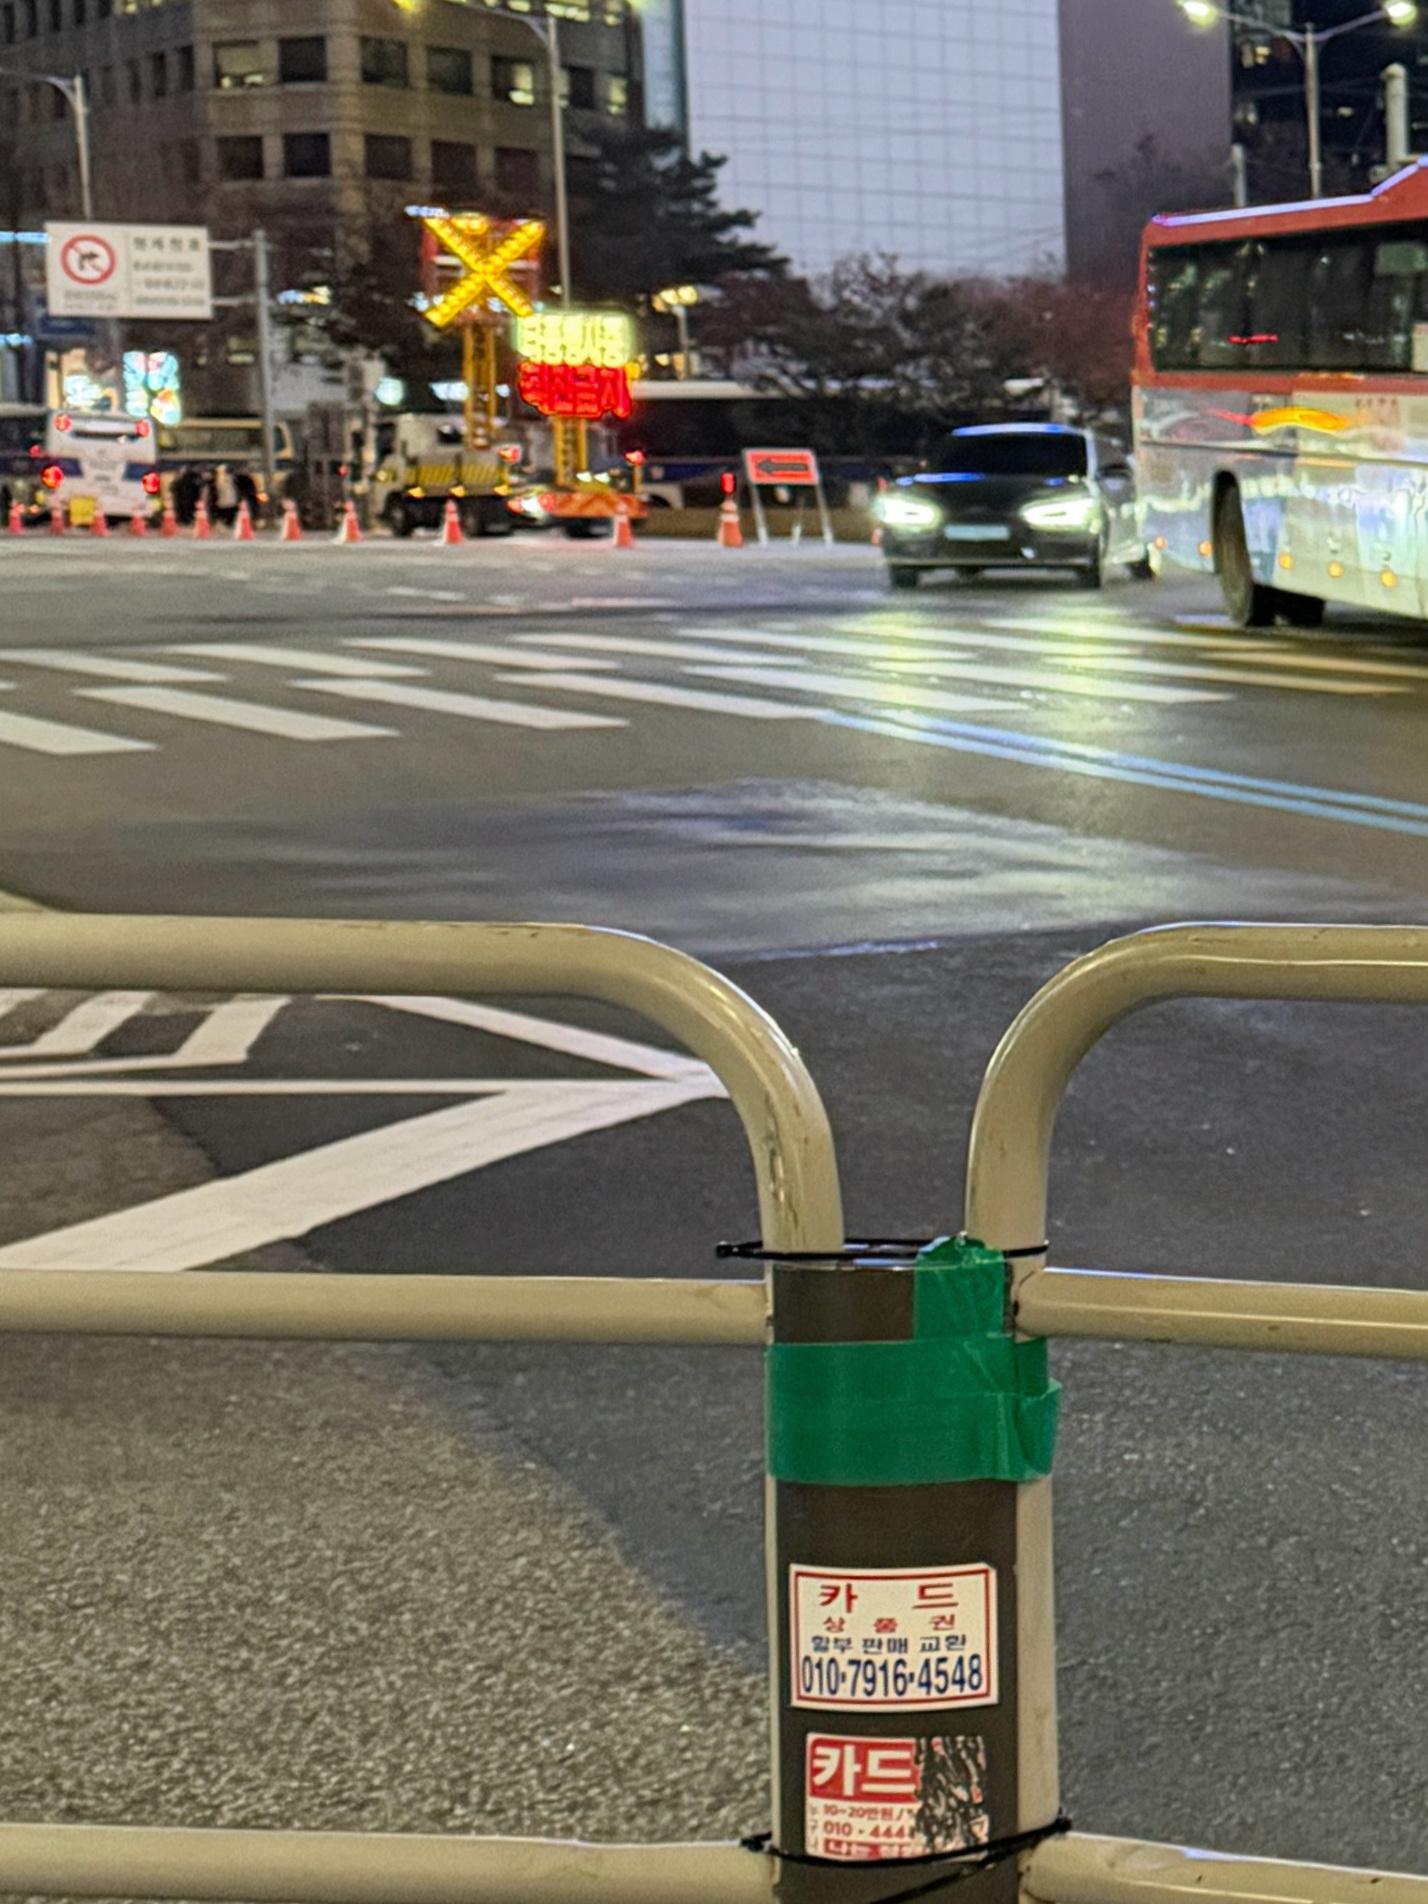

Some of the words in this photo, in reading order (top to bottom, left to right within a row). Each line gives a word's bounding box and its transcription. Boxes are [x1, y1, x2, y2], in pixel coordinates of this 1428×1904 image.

[811, 1636, 853, 1654] 할부
[862, 1637, 909, 1655] 판매
[919, 1634, 967, 1652] 교환
[812, 1742, 918, 1798] 카드
